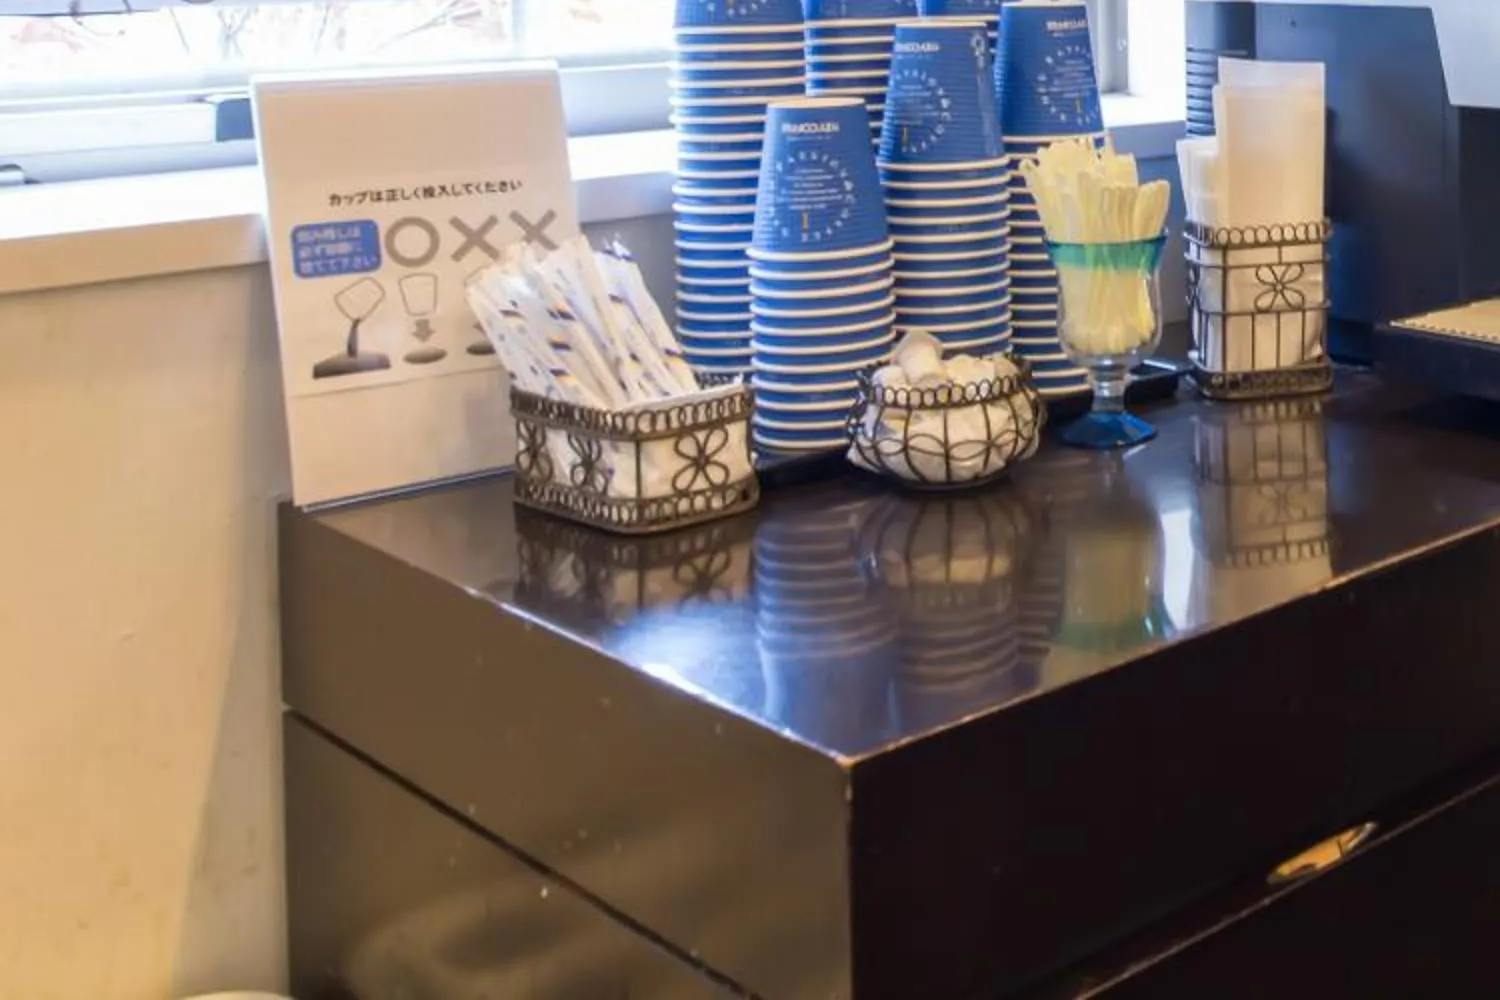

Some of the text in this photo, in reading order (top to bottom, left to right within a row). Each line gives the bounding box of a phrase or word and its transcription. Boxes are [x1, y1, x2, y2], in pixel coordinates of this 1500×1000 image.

[329, 179, 523, 207] カップは正しく投入してください
